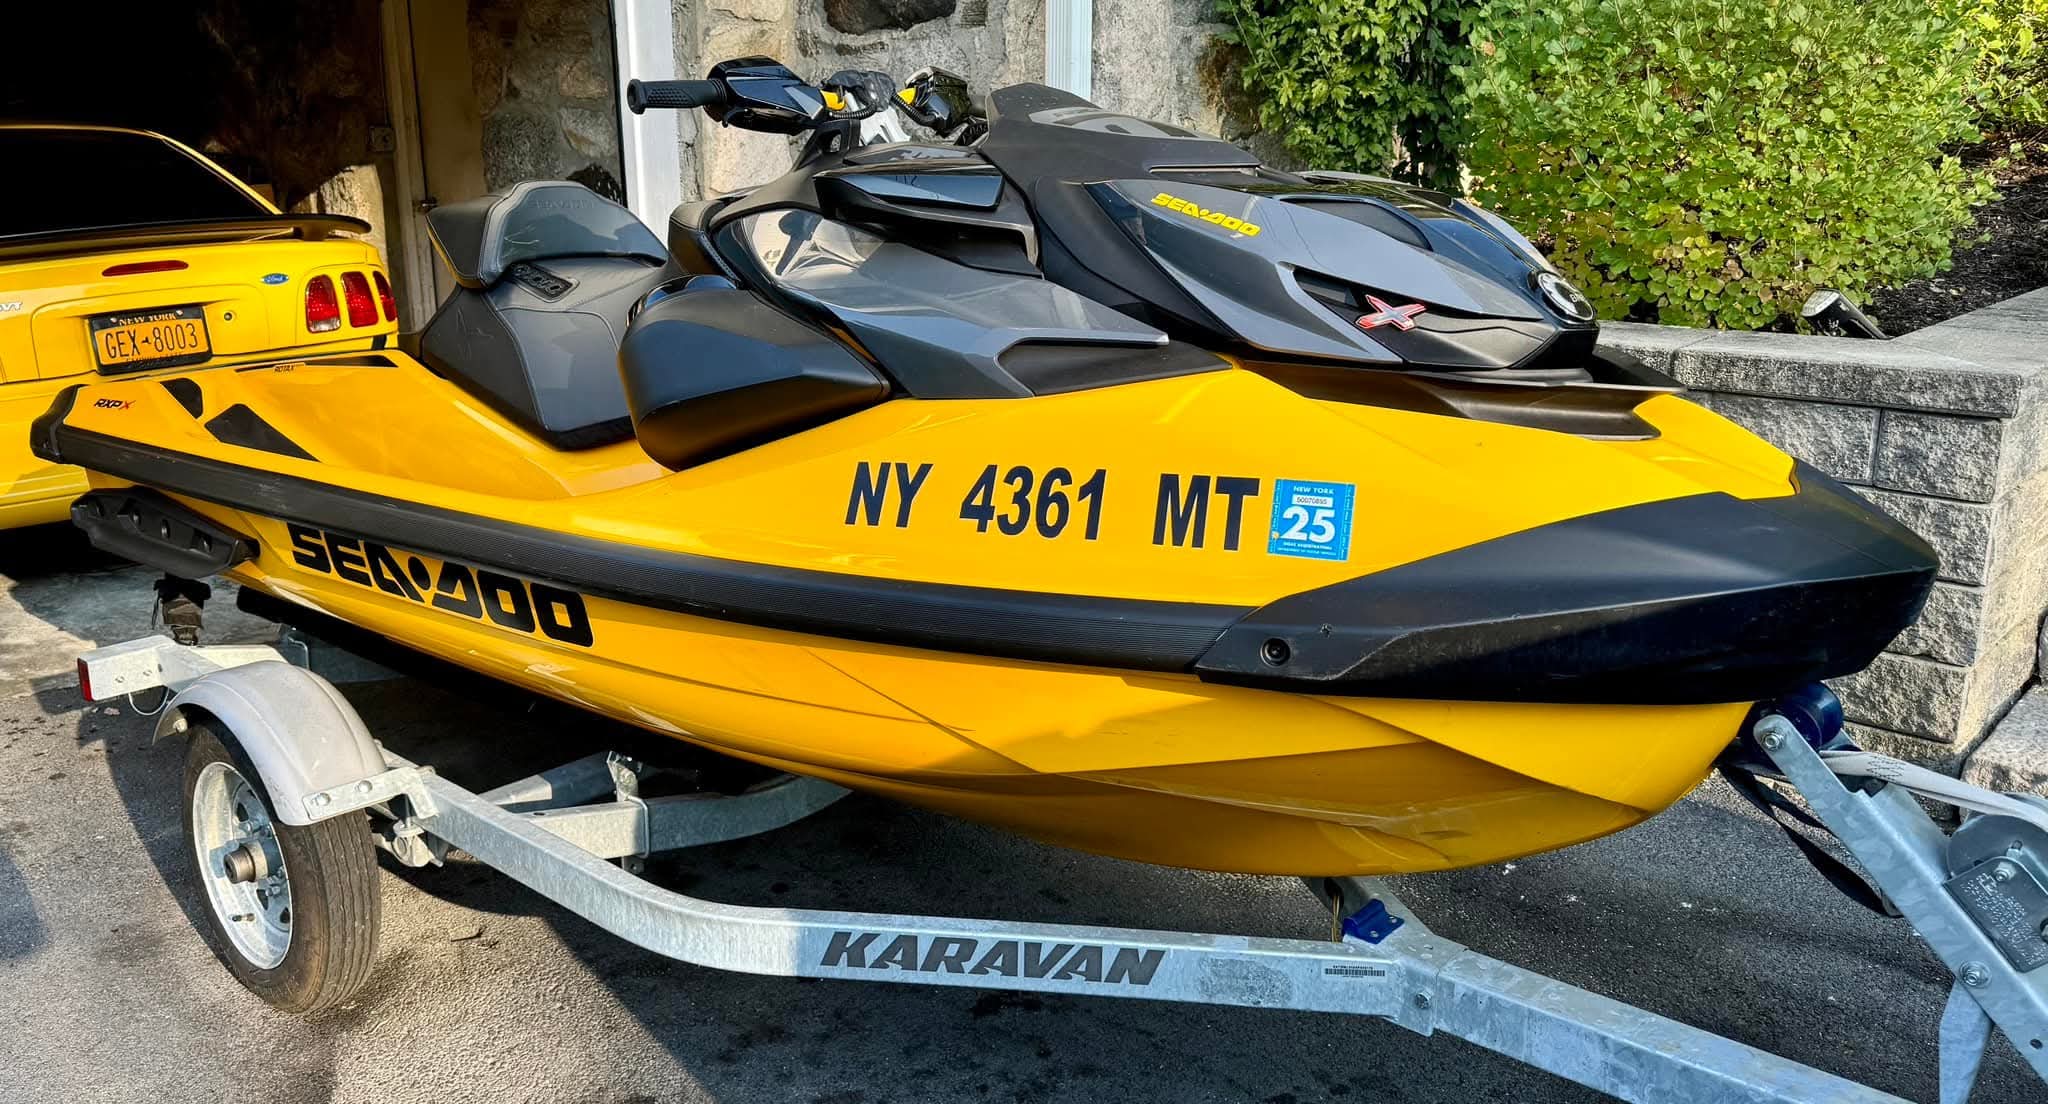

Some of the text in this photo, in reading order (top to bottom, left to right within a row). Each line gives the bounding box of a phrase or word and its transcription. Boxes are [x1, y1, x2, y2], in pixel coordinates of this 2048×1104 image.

[105, 322, 198, 359] GEX 8003
[844, 461, 933, 528] NY
[959, 464, 1107, 541] 4361
[1151, 472, 1260, 552] MT
[1292, 485, 1335, 495] NEW YORK
[1280, 505, 1336, 544] 25
[819, 930, 1168, 986] KARAVAN
